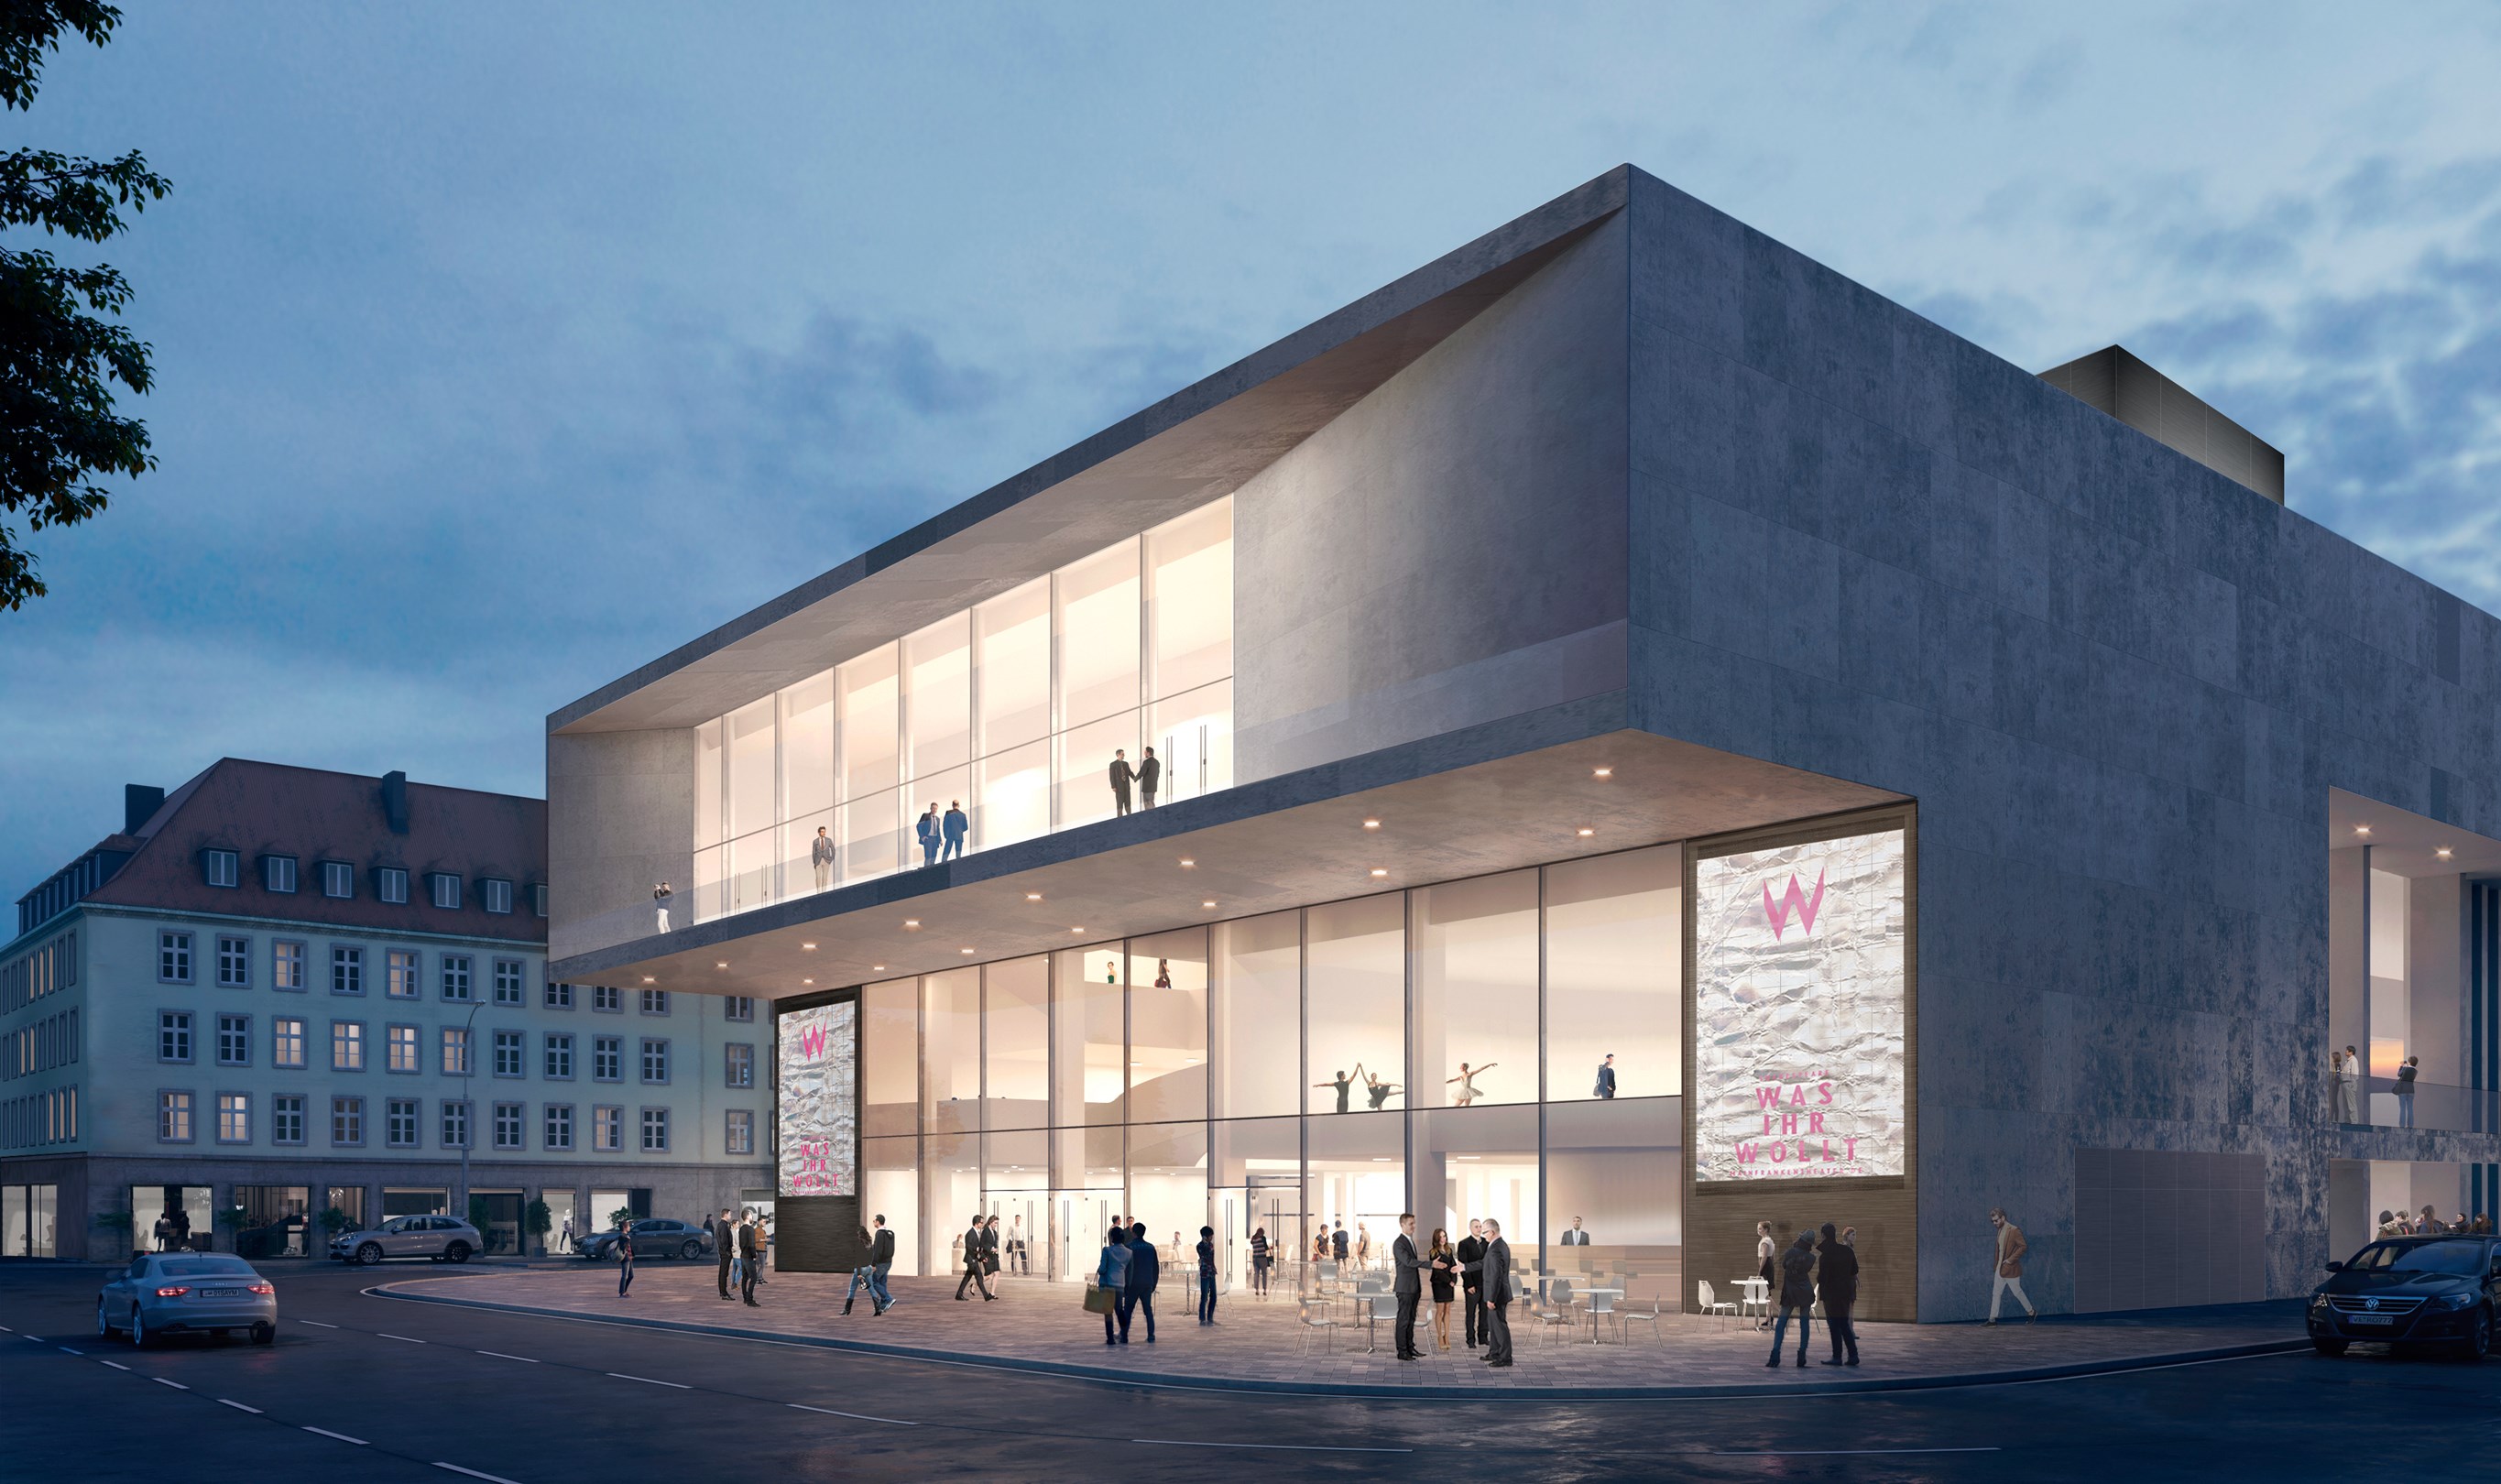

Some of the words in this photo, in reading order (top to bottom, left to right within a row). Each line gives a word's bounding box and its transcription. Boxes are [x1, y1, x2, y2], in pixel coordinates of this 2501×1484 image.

[1764, 867, 1825, 942] W
[803, 1021, 826, 1063] W
[1755, 1082, 1833, 1109] WAS
[1764, 1111, 1825, 1136] IHR
[800, 1142, 829, 1157] WAS
[1734, 1138, 1859, 1164] WOLLT
[803, 1159, 826, 1172] IHR
[792, 1173, 839, 1187] WOLLT
